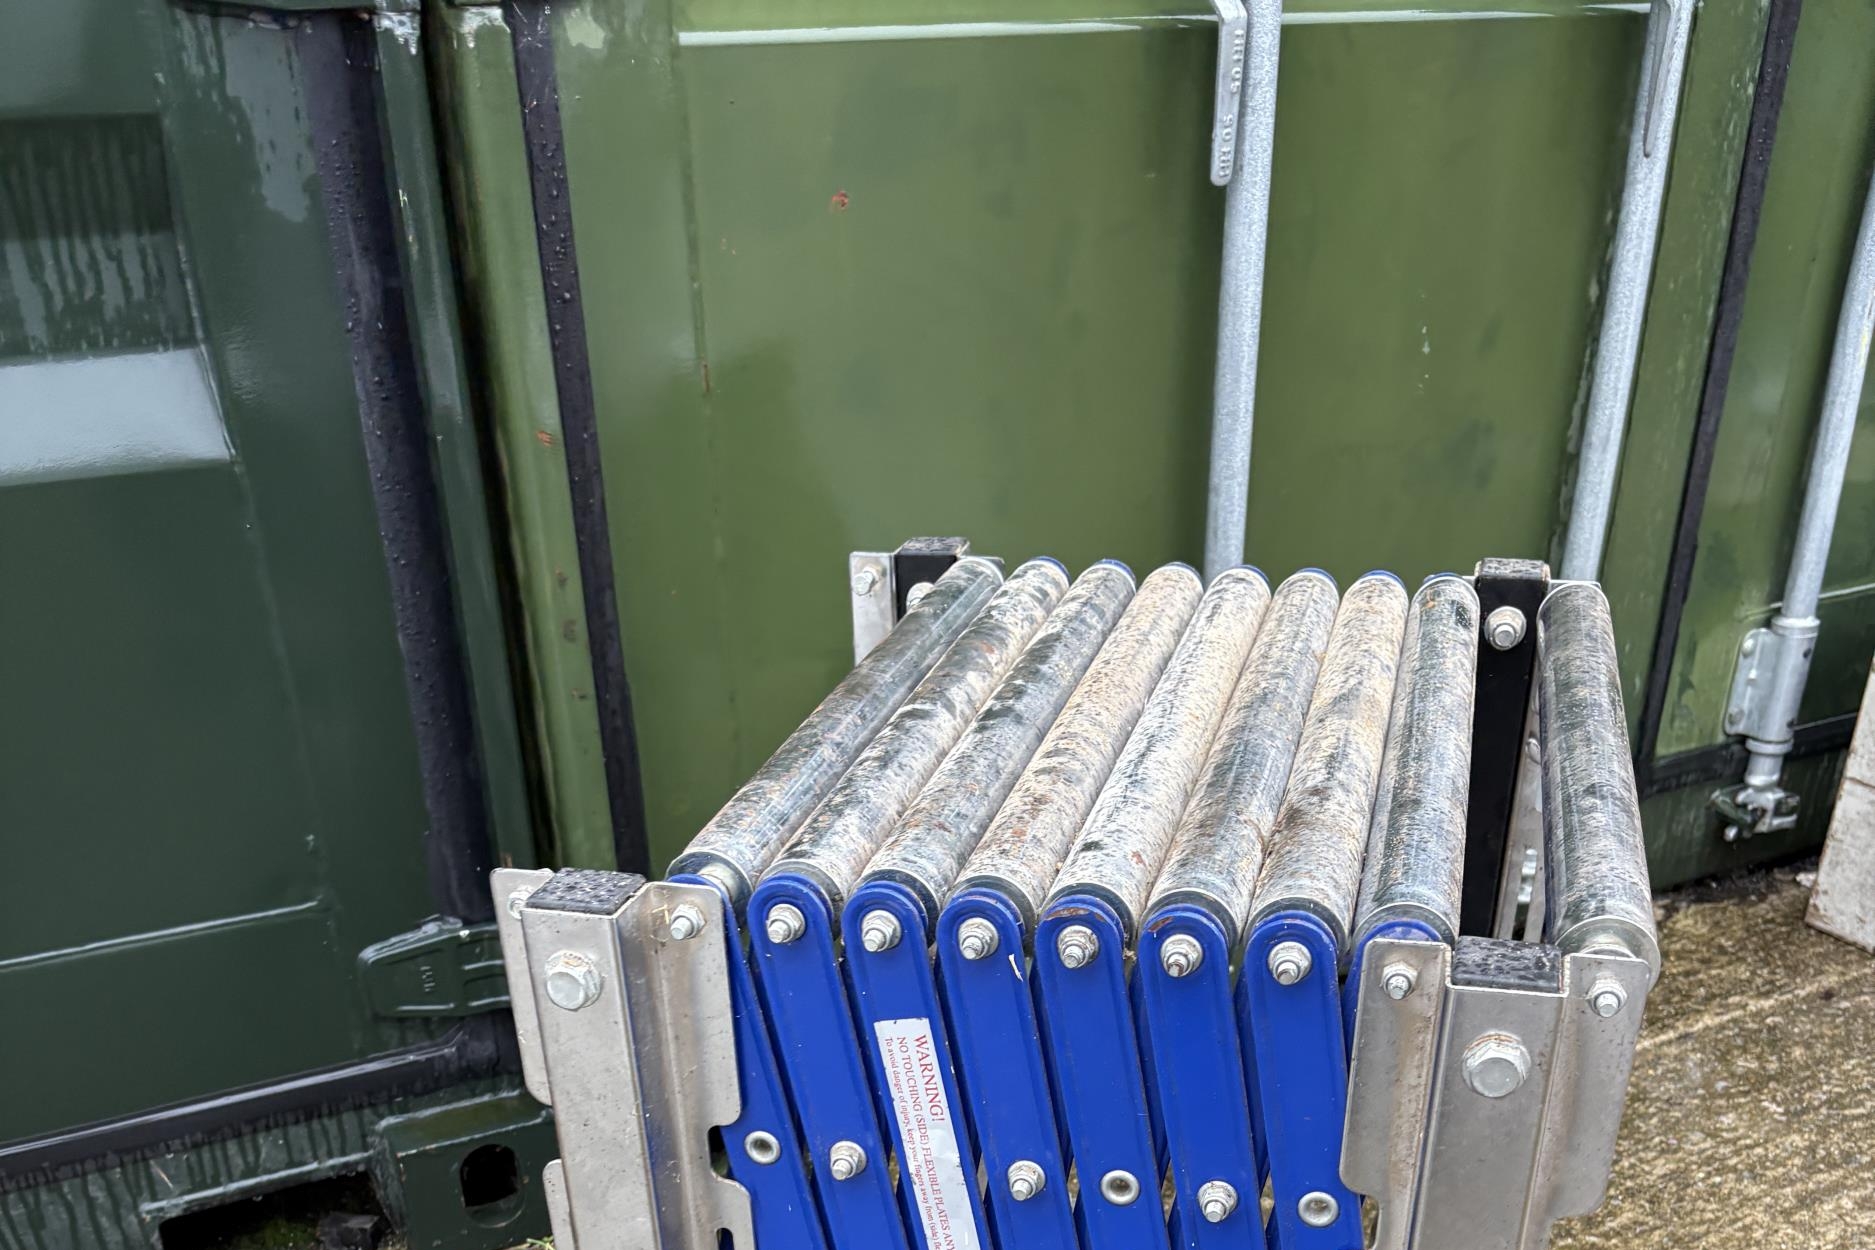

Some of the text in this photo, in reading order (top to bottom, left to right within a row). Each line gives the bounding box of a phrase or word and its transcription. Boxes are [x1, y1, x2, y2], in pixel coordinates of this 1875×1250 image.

[885, 1037, 893, 1047] To
[897, 1036, 908, 1053] NO
[887, 1048, 898, 1069] avoid
[893, 1070, 903, 1094] danger
[902, 1055, 922, 1111] TOUCHING
[914, 1035, 945, 1121] WARNING!
[907, 1128, 915, 1145] keep
[914, 1114, 929, 1144] (SIDE)
[909, 1146, 918, 1162] your
[914, 1164, 924, 1186] fingers
[922, 1147, 941, 1195] FLEXIBLE
[920, 1187, 928, 1204] away
[925, 1206, 933, 1221] from
[934, 1197, 950, 1231] PLATES
